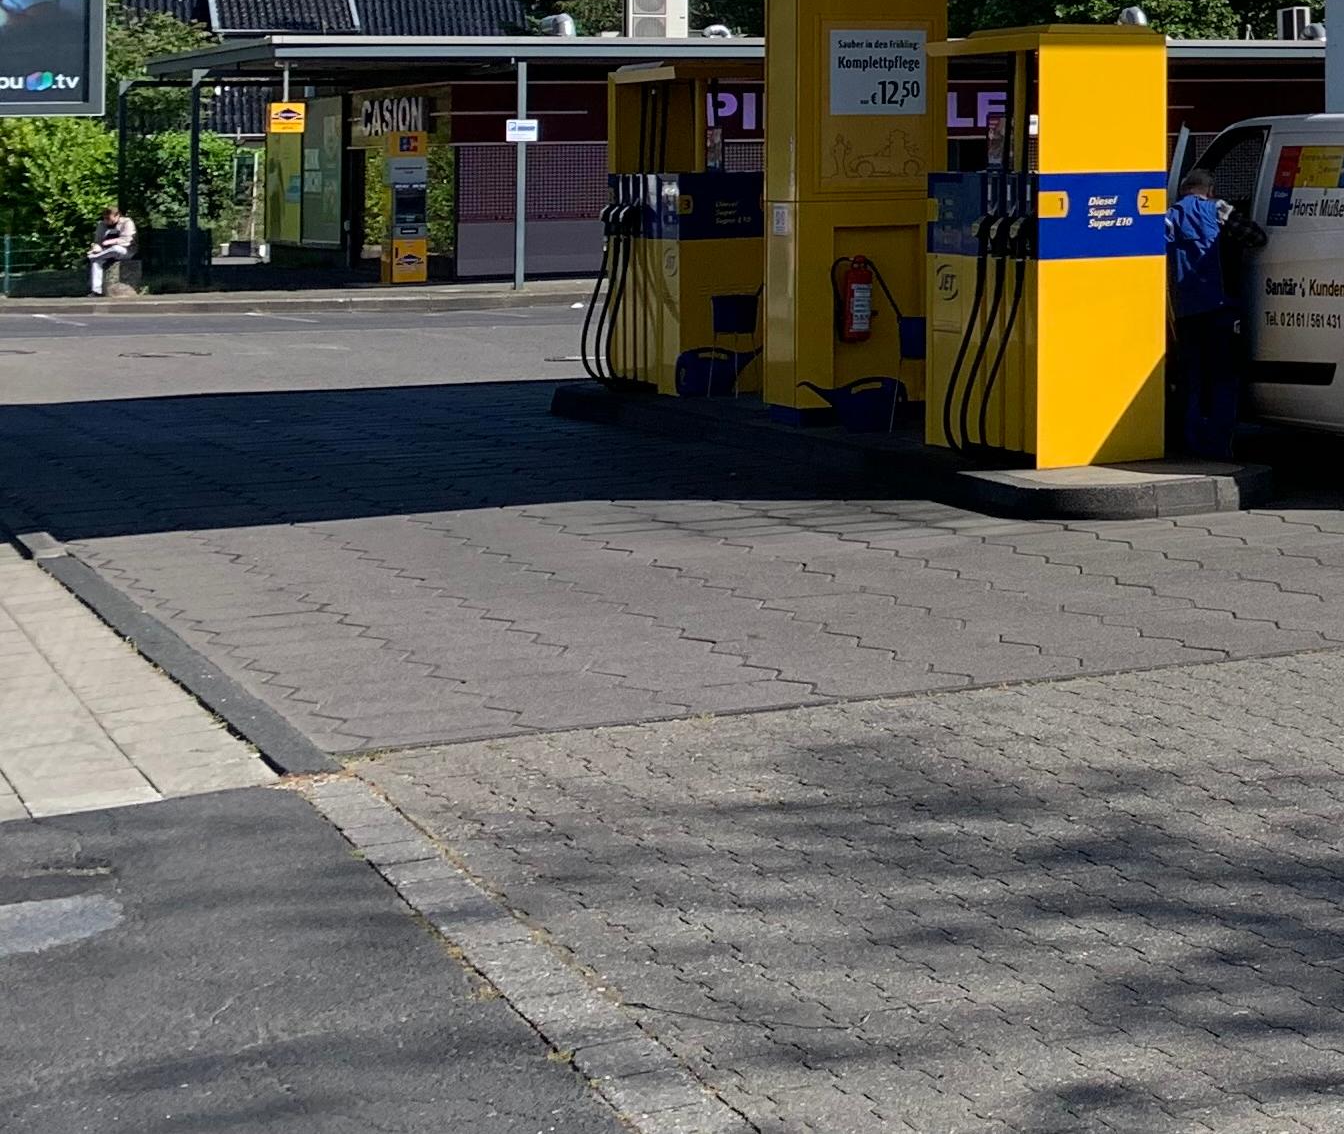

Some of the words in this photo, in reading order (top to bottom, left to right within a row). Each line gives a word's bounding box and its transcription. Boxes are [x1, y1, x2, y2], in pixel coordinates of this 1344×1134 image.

[838, 40, 864, 48] Sauber
[874, 40, 888, 48] den
[838, 55, 920, 72] Komplettpflege
[361, 97, 423, 136] CASION
[1058, 198, 1064, 211] 1
[1088, 196, 1118, 206] Diesel
[1141, 195, 1149, 208] 2
[1293, 199, 1318, 216] Horst
[1088, 207, 1115, 219] Super
[1088, 219, 1115, 230] Super
[1116, 217, 1133, 226] E10
[1265, 277, 1296, 296] Sanitär
[1265, 311, 1279, 326] Tel.
